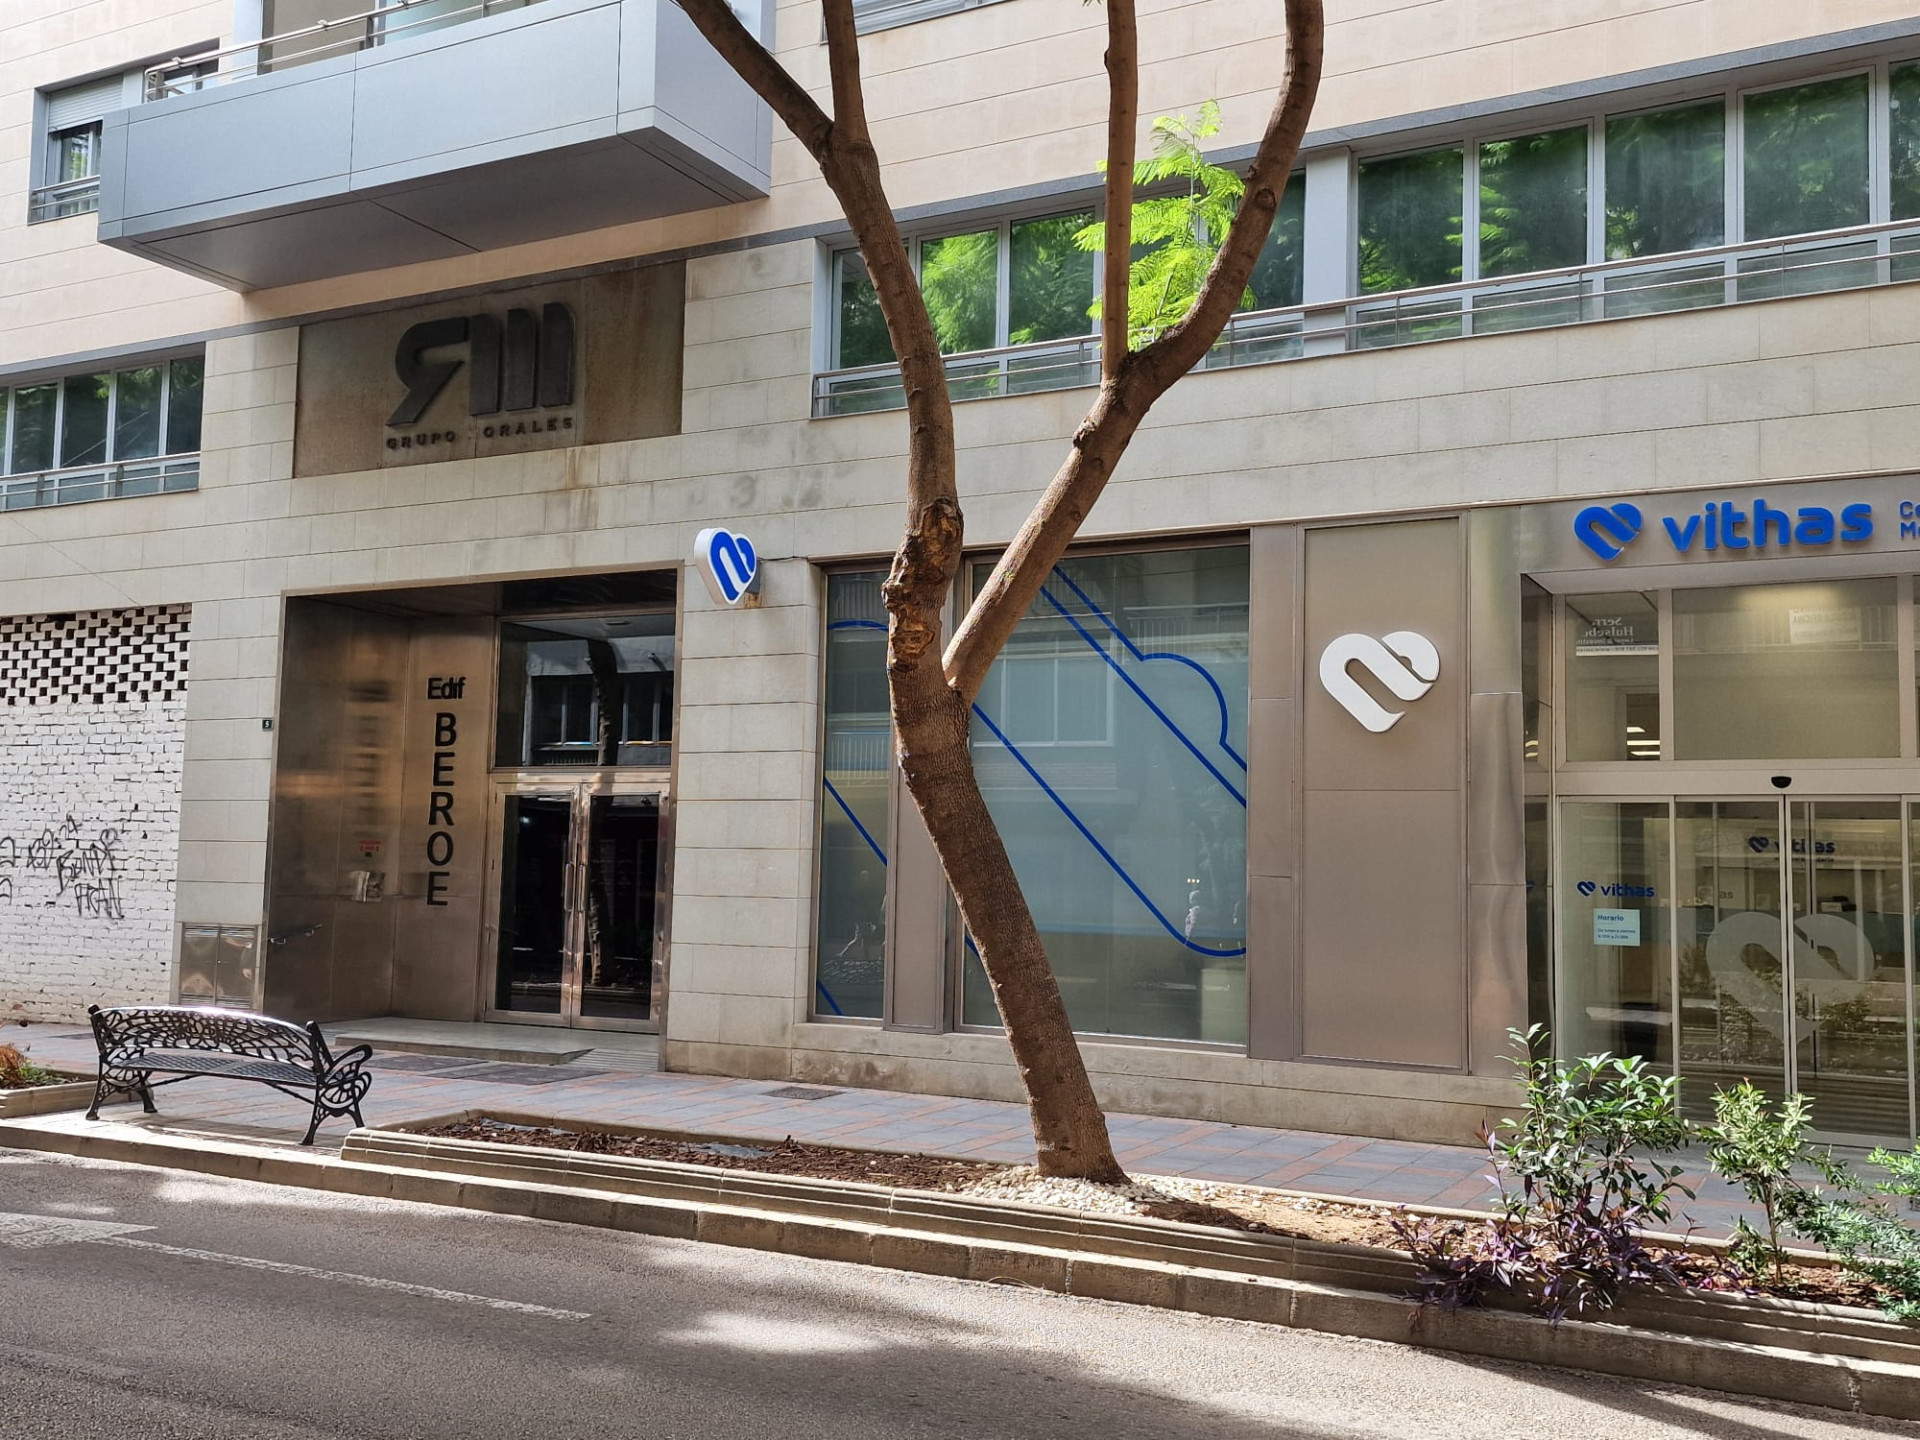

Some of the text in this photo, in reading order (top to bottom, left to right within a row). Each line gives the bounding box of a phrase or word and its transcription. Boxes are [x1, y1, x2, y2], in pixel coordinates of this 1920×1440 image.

[386, 431, 456, 450] GRUPO
[1662, 499, 1874, 552] vithas
[427, 677, 466, 699] Edif
[426, 712, 457, 906] BEROE
[1774, 838, 1836, 854] tas
[1601, 883, 1655, 898] vithas
[1597, 914, 1624, 922] Horario
